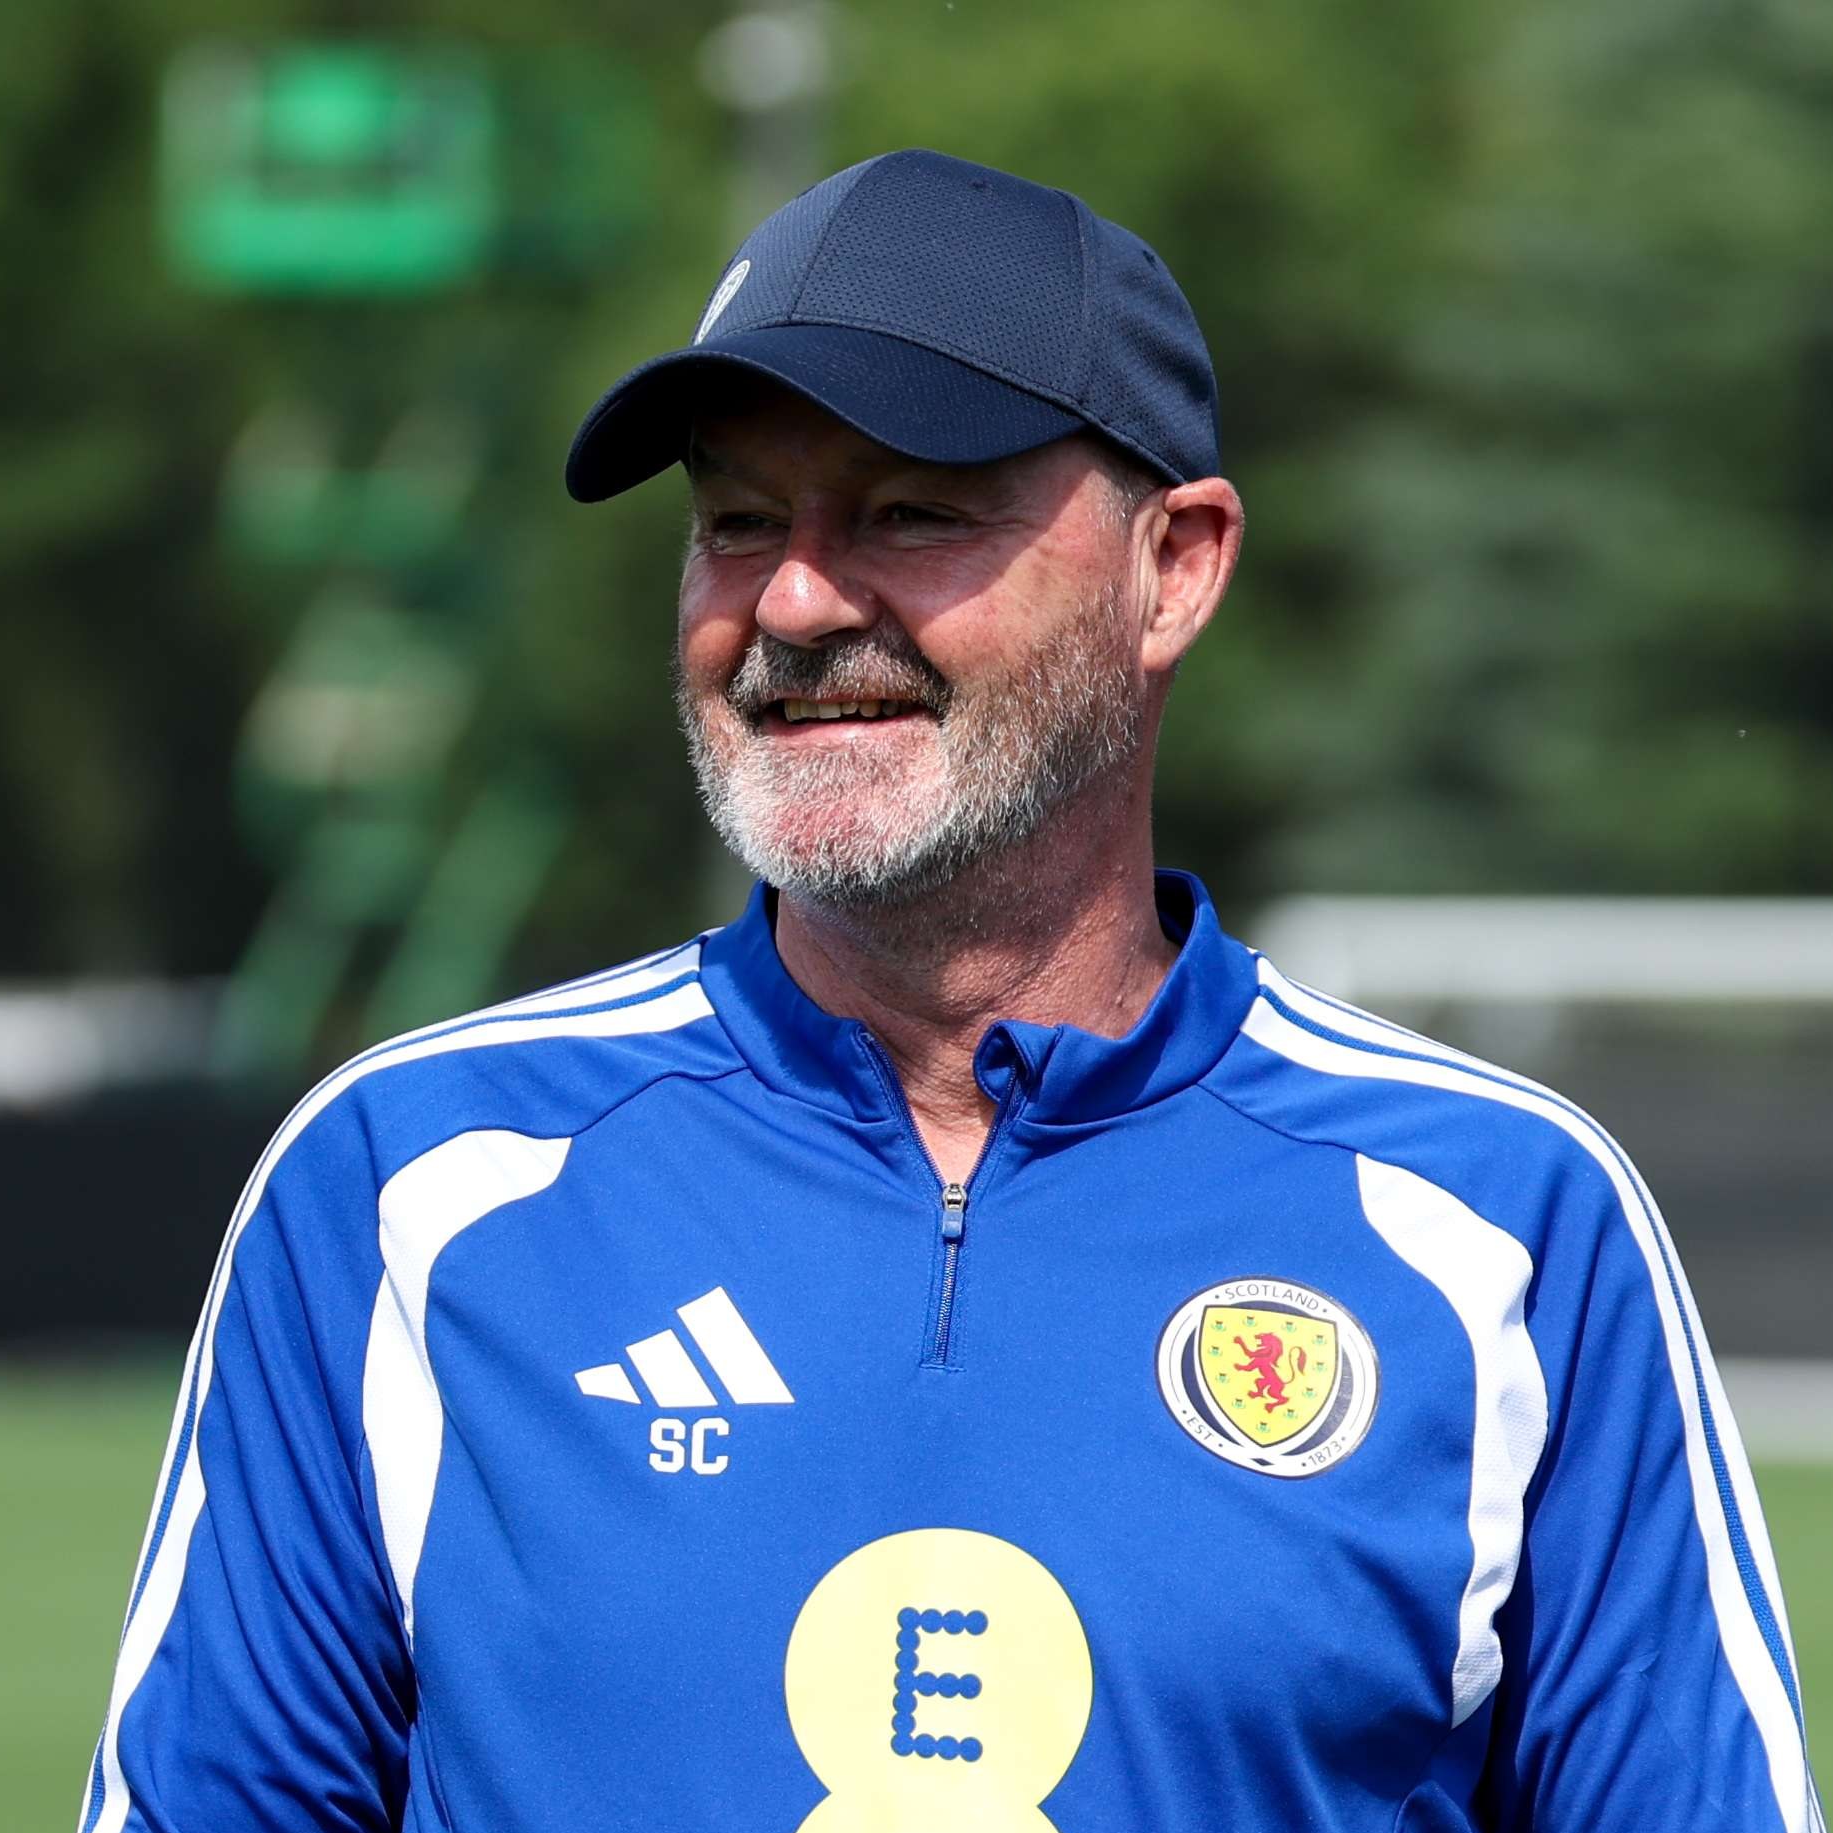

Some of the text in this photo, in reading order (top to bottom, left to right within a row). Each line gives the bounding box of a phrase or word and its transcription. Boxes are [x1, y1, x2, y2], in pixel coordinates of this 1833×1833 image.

[1225, 1284, 1319, 1311] SCOTLAND
[1186, 1415, 1214, 1442] EST
[649, 1417, 730, 1475] SC
[1308, 1440, 1344, 1466] 1873
